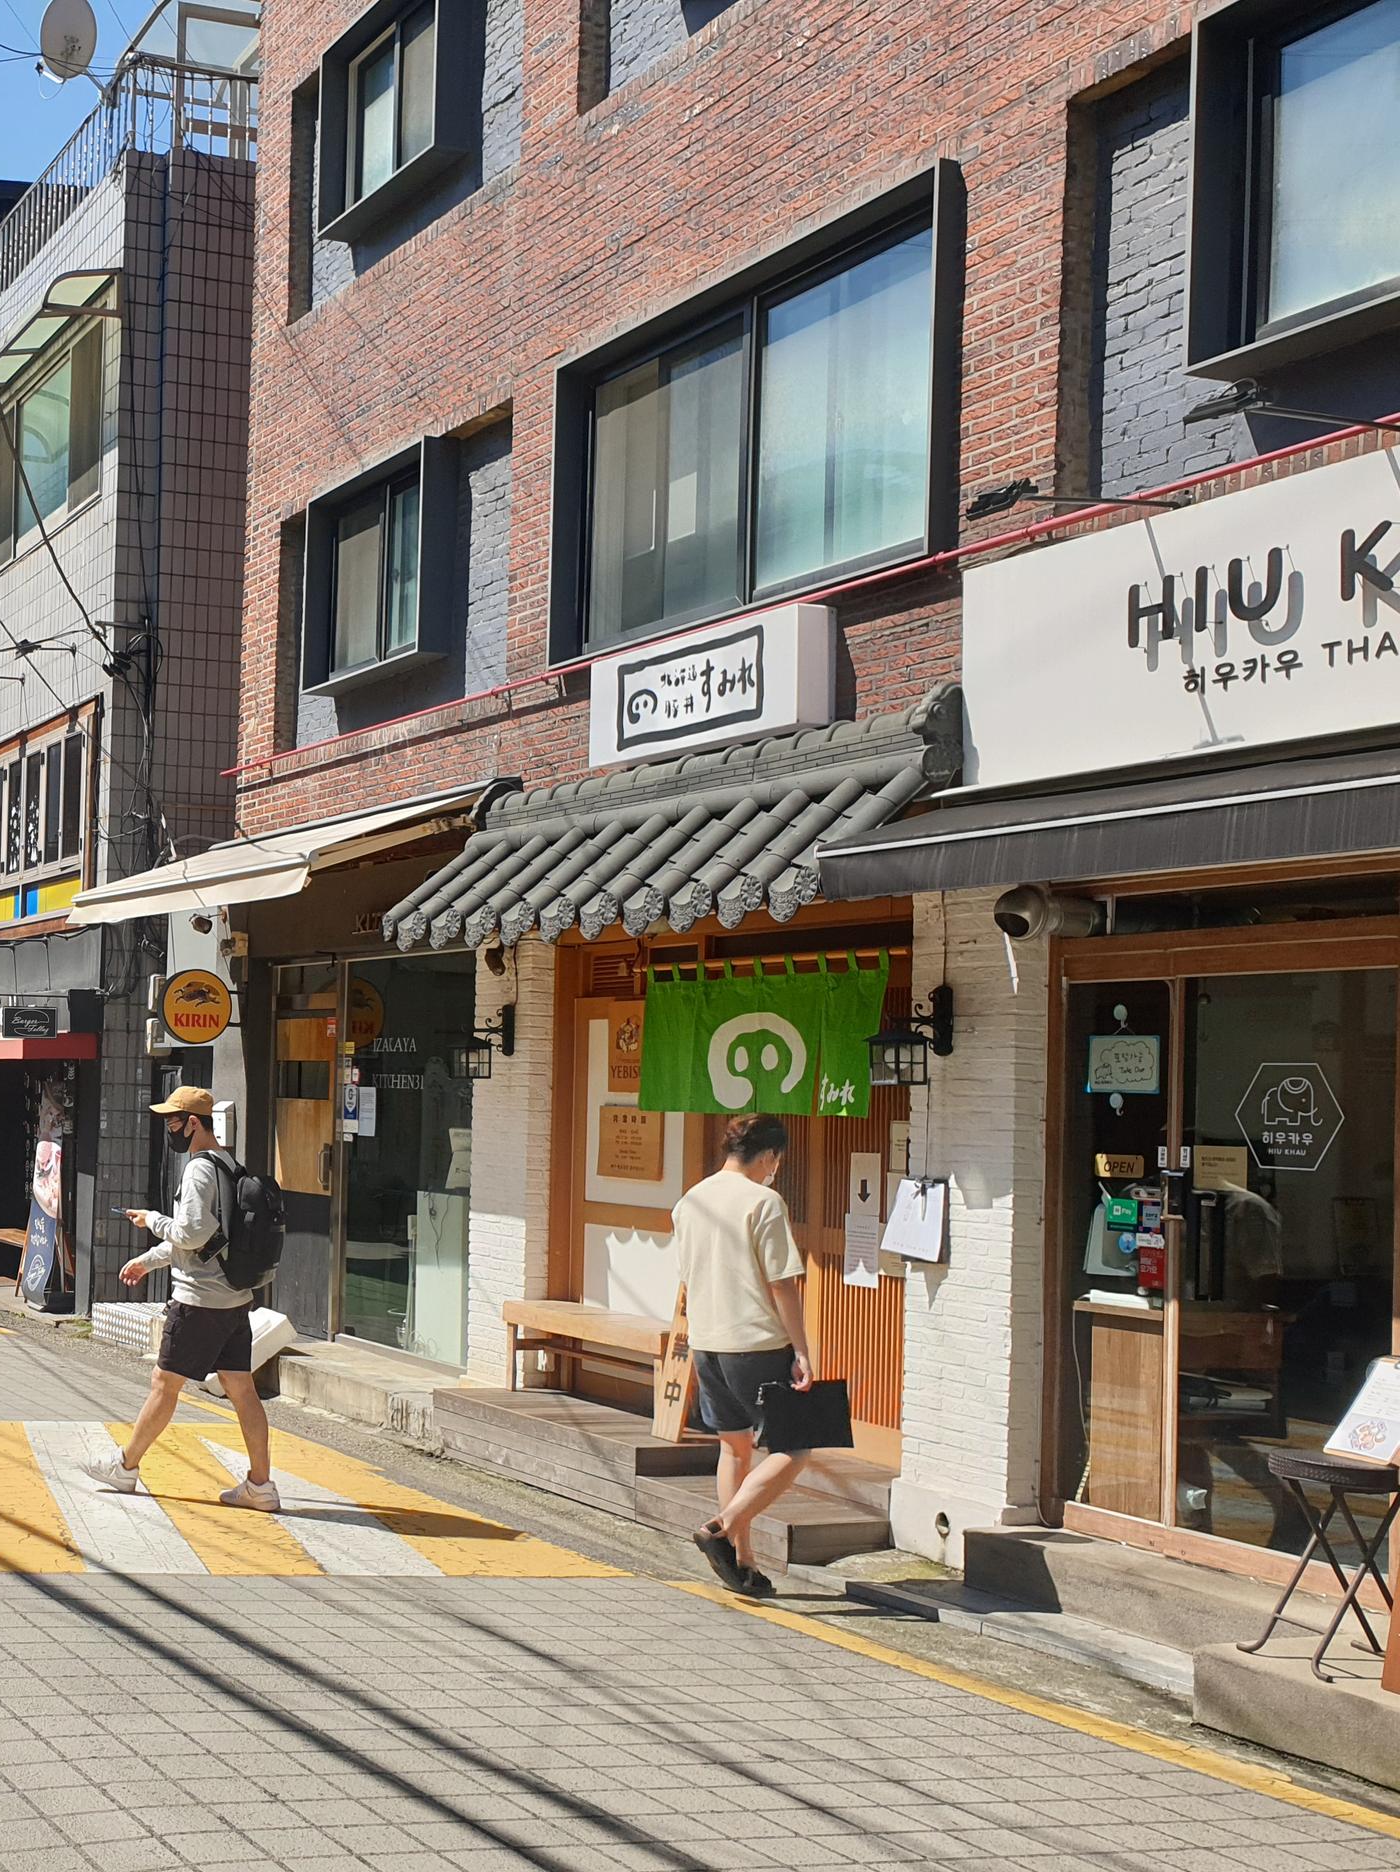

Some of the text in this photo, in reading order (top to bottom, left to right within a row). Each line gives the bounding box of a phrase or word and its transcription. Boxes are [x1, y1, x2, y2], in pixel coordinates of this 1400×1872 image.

[1128, 546, 1282, 648] HIU
[1183, 631, 1399, 695] 히우카우 THA
[699, 657, 755, 713] すみれ
[174, 1013, 219, 1028] KIRIN
[819, 1071, 856, 1112] すみれ
[1261, 1131, 1314, 1146] 히우카우
[1284, 1148, 1307, 1156] KHAU
[1103, 1160, 1136, 1174] OPEN
